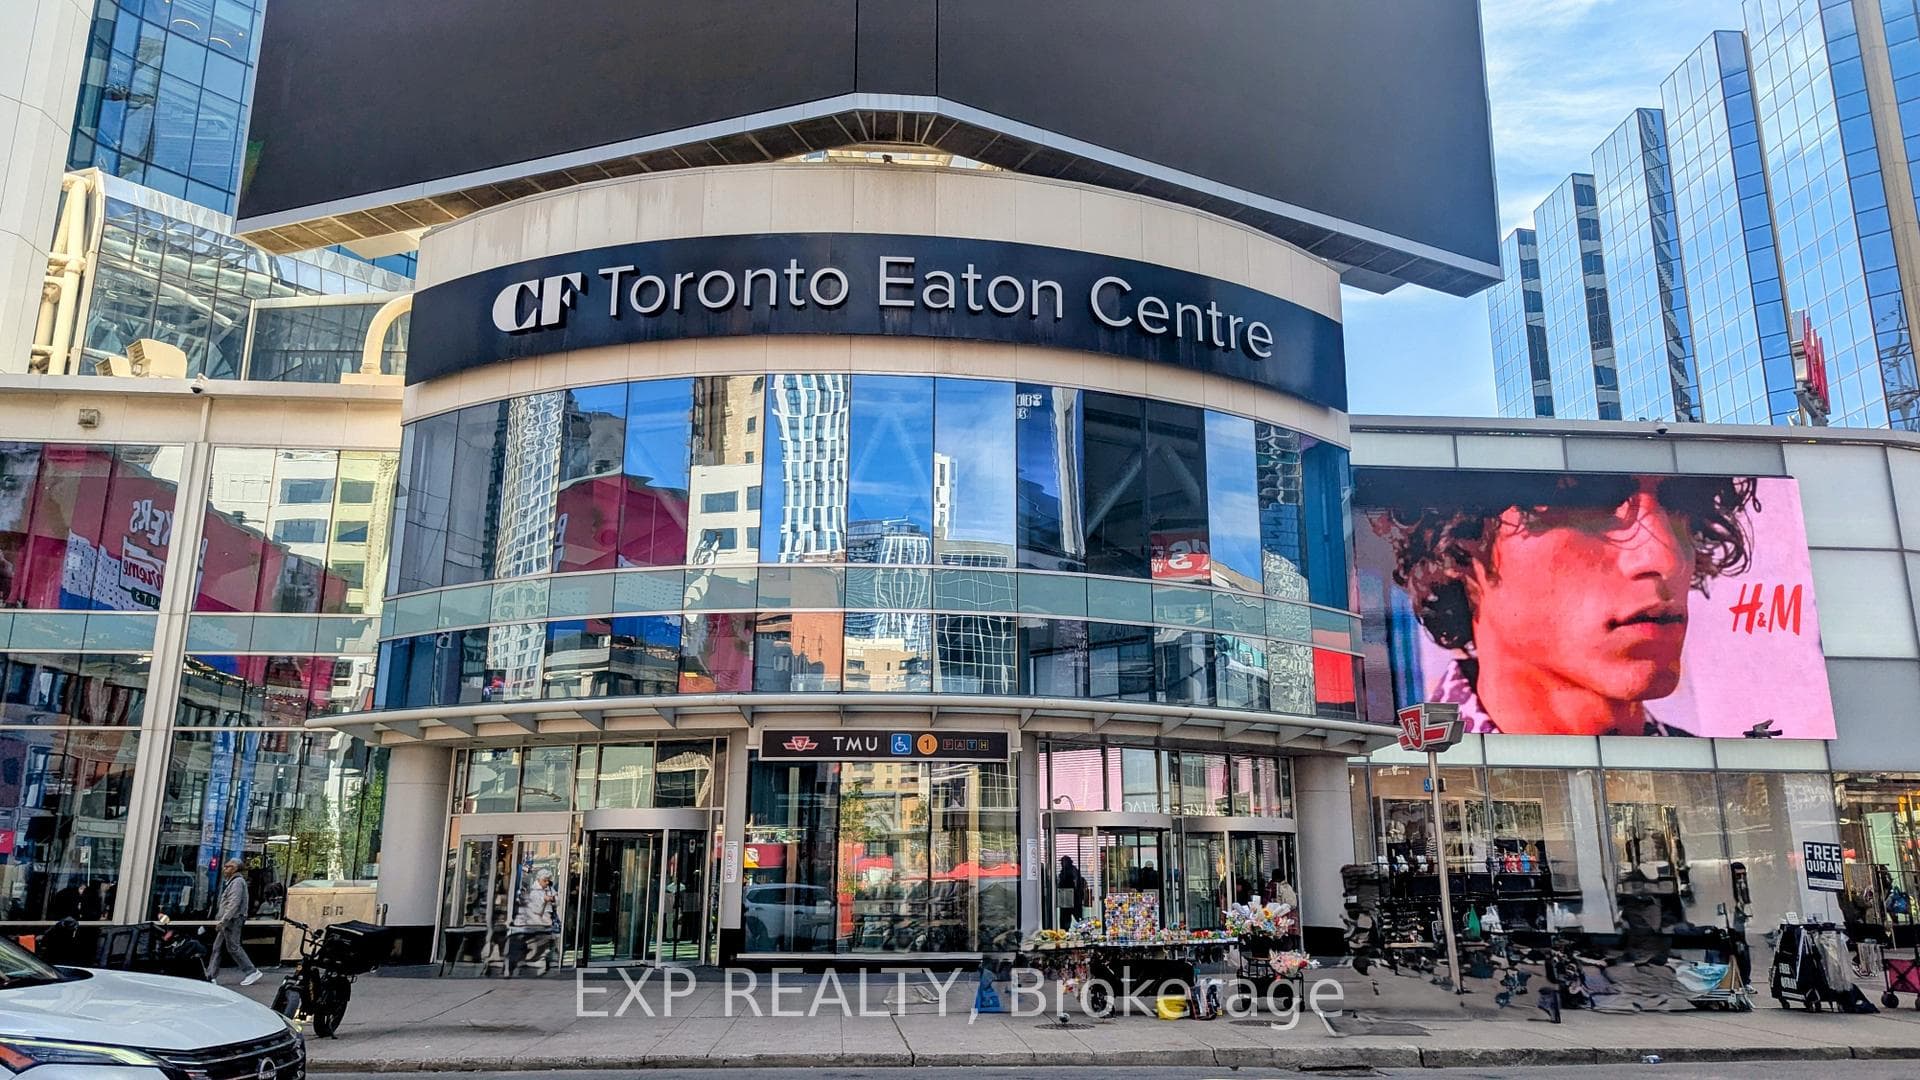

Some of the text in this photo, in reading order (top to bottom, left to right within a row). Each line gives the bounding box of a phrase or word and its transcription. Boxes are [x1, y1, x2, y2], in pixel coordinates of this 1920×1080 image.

[492, 255, 1274, 358] CF Toronto Eaton Centre
[1729, 583, 1802, 635] H&M
[833, 736, 878, 751] TMU
[943, 739, 989, 750] PATH
[1805, 844, 1841, 861] FREE
[1807, 860, 1842, 873] QURAN
